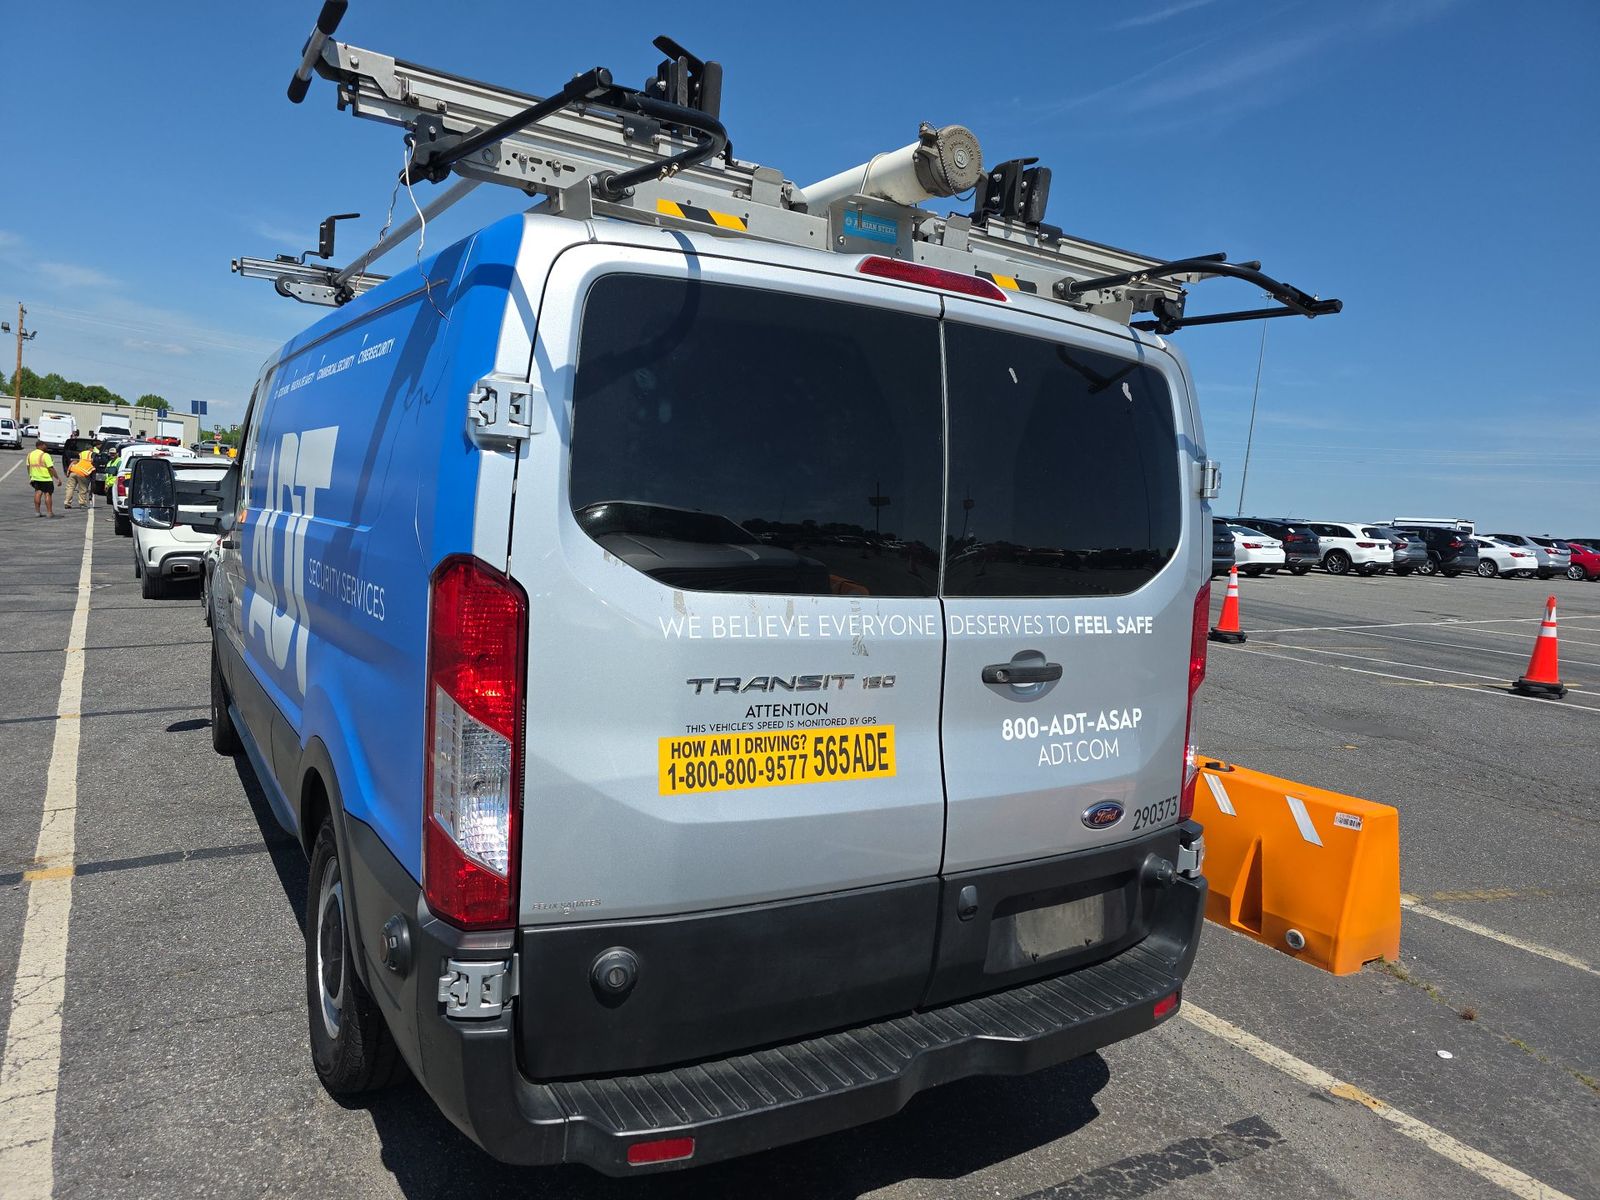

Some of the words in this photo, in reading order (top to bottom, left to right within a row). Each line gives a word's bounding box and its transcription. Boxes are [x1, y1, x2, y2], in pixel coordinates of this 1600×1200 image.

[854, 219, 877, 231] ARIAN
[878, 225, 896, 235] STEEL
[249, 425, 339, 698] ADT
[308, 558, 341, 597] SECURITY
[341, 572, 385, 622] SERVICES
[659, 615, 702, 639] WE
[712, 615, 810, 638] BELIEVE
[819, 614, 937, 637] EVERYONE
[950, 614, 1044, 635] DESERVES
[1047, 615, 1070, 635] TO
[1074, 615, 1112, 634] FEEL
[1117, 616, 1153, 634] SAFE
[687, 673, 855, 695] TRANSIT
[862, 675, 897, 689] 150
[745, 702, 829, 718] ATTENTION
[686, 724, 706, 734] THIS
[709, 721, 754, 732] VEHICLE'S
[757, 720, 785, 730] SPEED
[787, 720, 794, 729] IS
[797, 717, 848, 728] MONITORED
[849, 717, 860, 726] BY
[861, 716, 877, 725] GPS
[1001, 708, 1142, 741] 800-ADT-ASAP
[670, 740, 706, 760] HOW
[709, 738, 733, 757] AM
[736, 738, 740, 755] I
[744, 734, 807, 755] DRIVING?
[1038, 737, 1120, 767] ADT.COM
[667, 753, 808, 790] 1-800-800-9577
[1094, 807, 1119, 824] Ford
[1132, 795, 1178, 831] 290373
